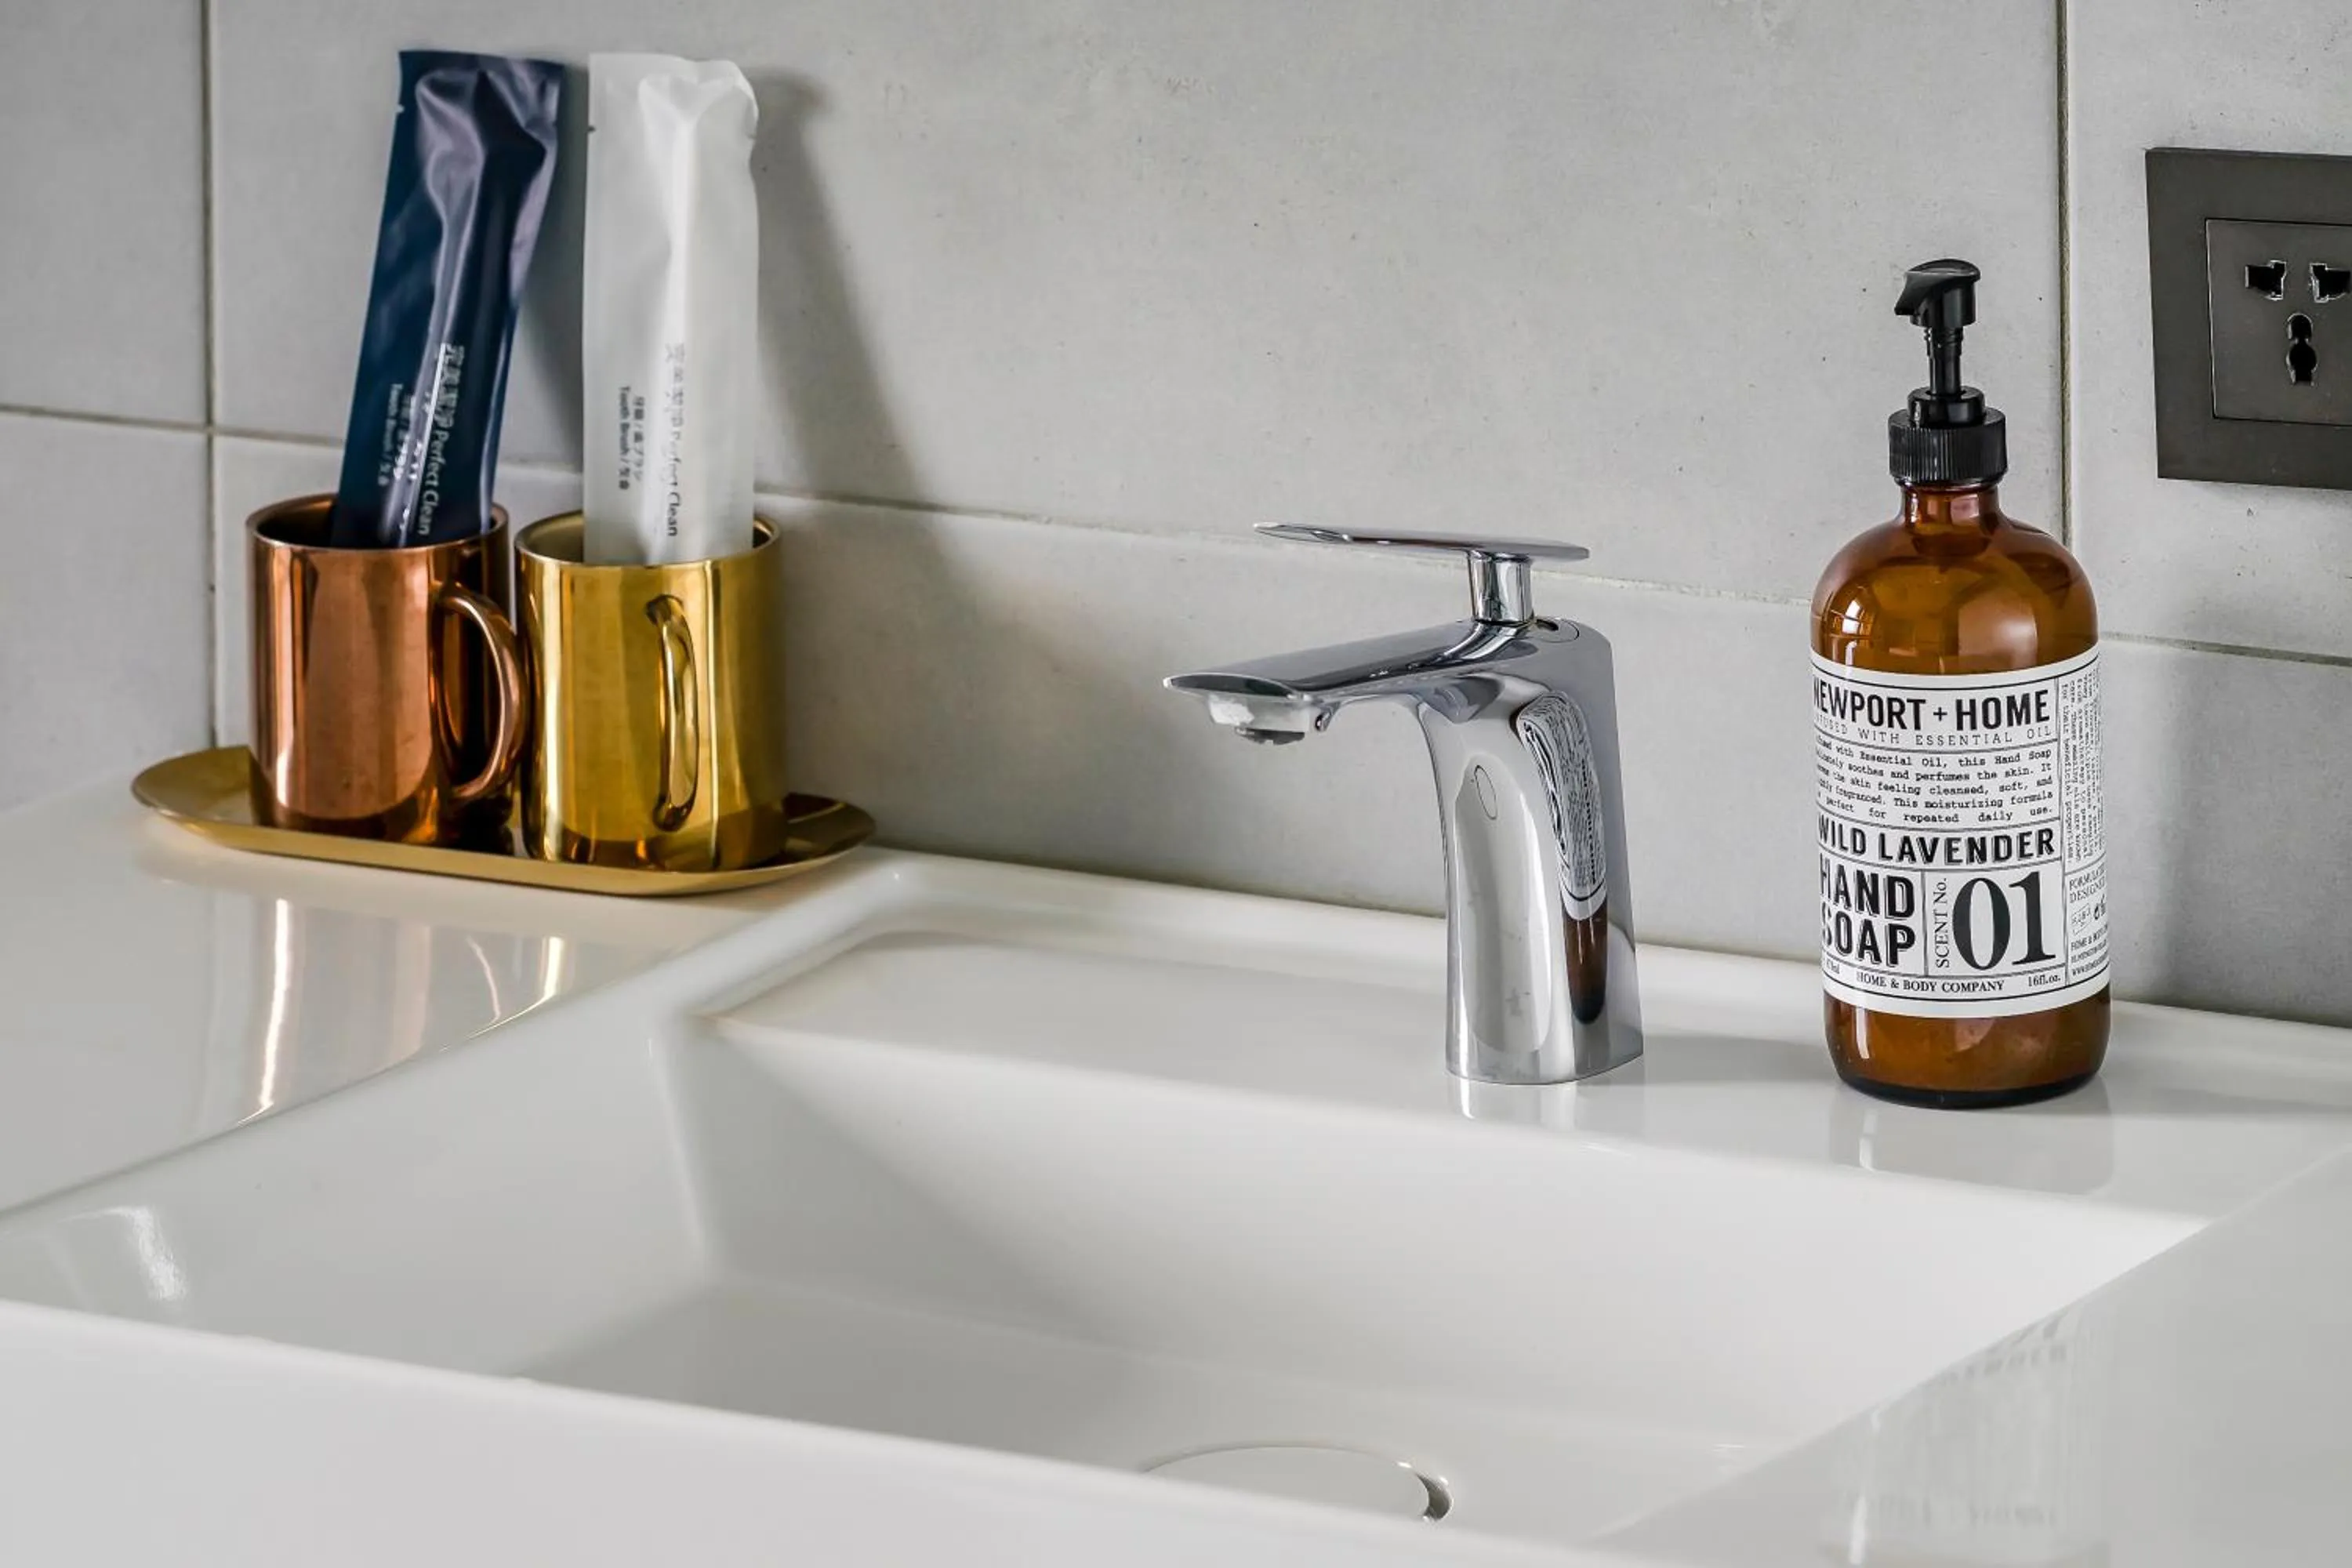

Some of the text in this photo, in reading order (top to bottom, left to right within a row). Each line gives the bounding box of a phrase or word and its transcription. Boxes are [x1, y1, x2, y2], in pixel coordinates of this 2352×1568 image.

[619, 386, 630, 419] Tooth
[426, 430, 450, 486] Perfect
[619, 423, 630, 456] Brush
[419, 489, 440, 535] Clean
[666, 491, 681, 536] Clean
[1813, 676, 2050, 731] NEWPORT + HOME
[1857, 728, 1900, 744] WITH
[1915, 731, 2013, 746] ESSENTIAL
[2027, 726, 2052, 739] OIL
[1848, 763, 1884, 776] soothes
[1890, 771, 1910, 779] and
[1915, 772, 1970, 782] perfumes
[1977, 771, 1998, 779] the
[2005, 767, 2034, 777] skin.
[2042, 763, 2052, 771] It
[1860, 751, 1912, 766] Essential
[1922, 758, 1947, 768] Oil,
[1958, 758, 1986, 768] this
[1994, 753, 2020, 764] Hand
[2028, 749, 2052, 760] Soap
[1849, 777, 1871, 789] skin
[1878, 783, 1922, 796] feeling
[1929, 785, 1989, 796] cleansed,
[1999, 782, 2028, 793] soft,
[2036, 775, 2053, 786] and
[1893, 798, 1918, 808] This
[1925, 797, 2003, 809] moisturizing
[2010, 790, 2053, 805] formula
[1868, 807, 1887, 819] for
[1904, 812, 1959, 823] repeated
[1978, 811, 2013, 822] daily
[2030, 807, 2053, 816] use.
[1818, 814, 2056, 864] WILD LAVENDER
[1819, 852, 1915, 921] HAND
[1820, 902, 1917, 968] SOAP
[1934, 877, 1949, 968] SCENT No.
[1951, 871, 2056, 971] 01
[1856, 971, 2005, 993] HOME & BODY COMPANY
